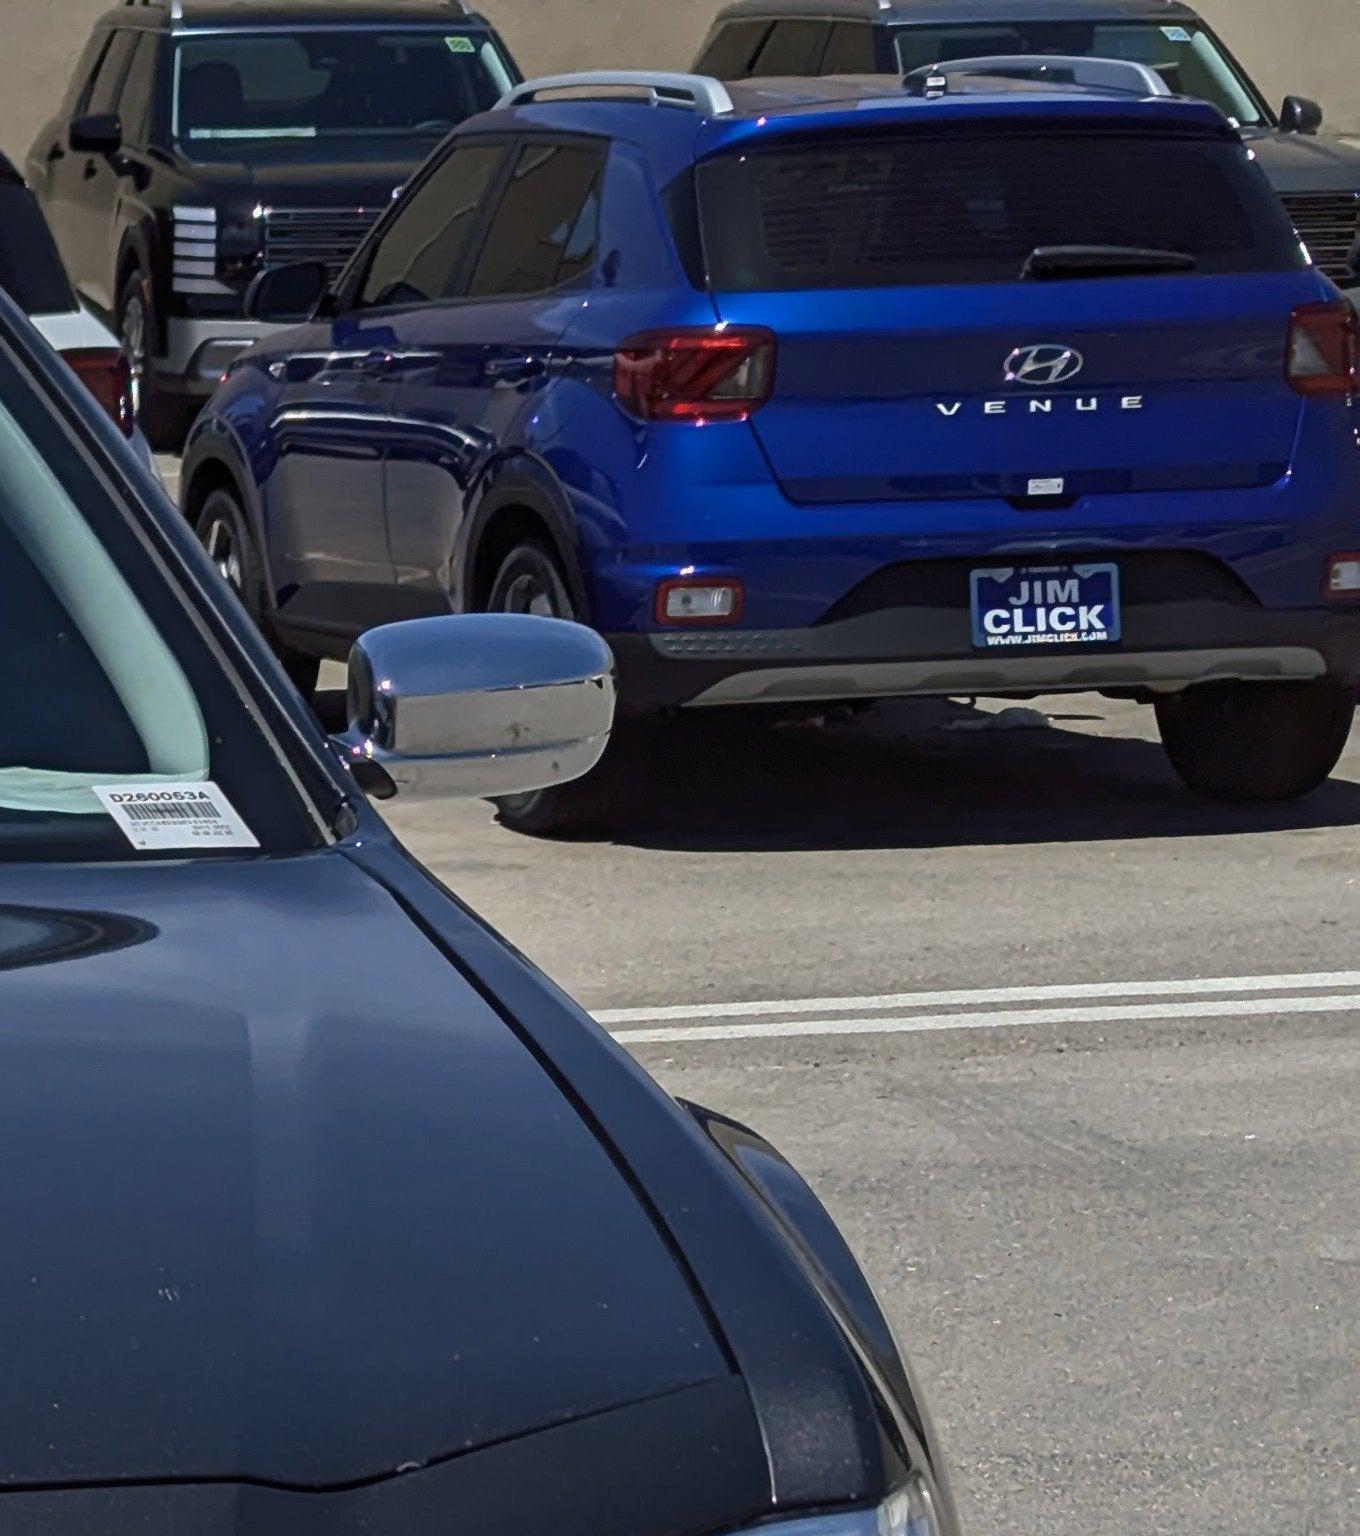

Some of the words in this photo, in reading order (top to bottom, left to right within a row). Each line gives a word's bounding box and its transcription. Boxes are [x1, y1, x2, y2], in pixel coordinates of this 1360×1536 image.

[935, 395, 1143, 416] VENUE
[1008, 578, 1080, 606] JIM
[983, 604, 1106, 634] CLICK
[986, 631, 1108, 646] WWW.JIMCLICK.COM
